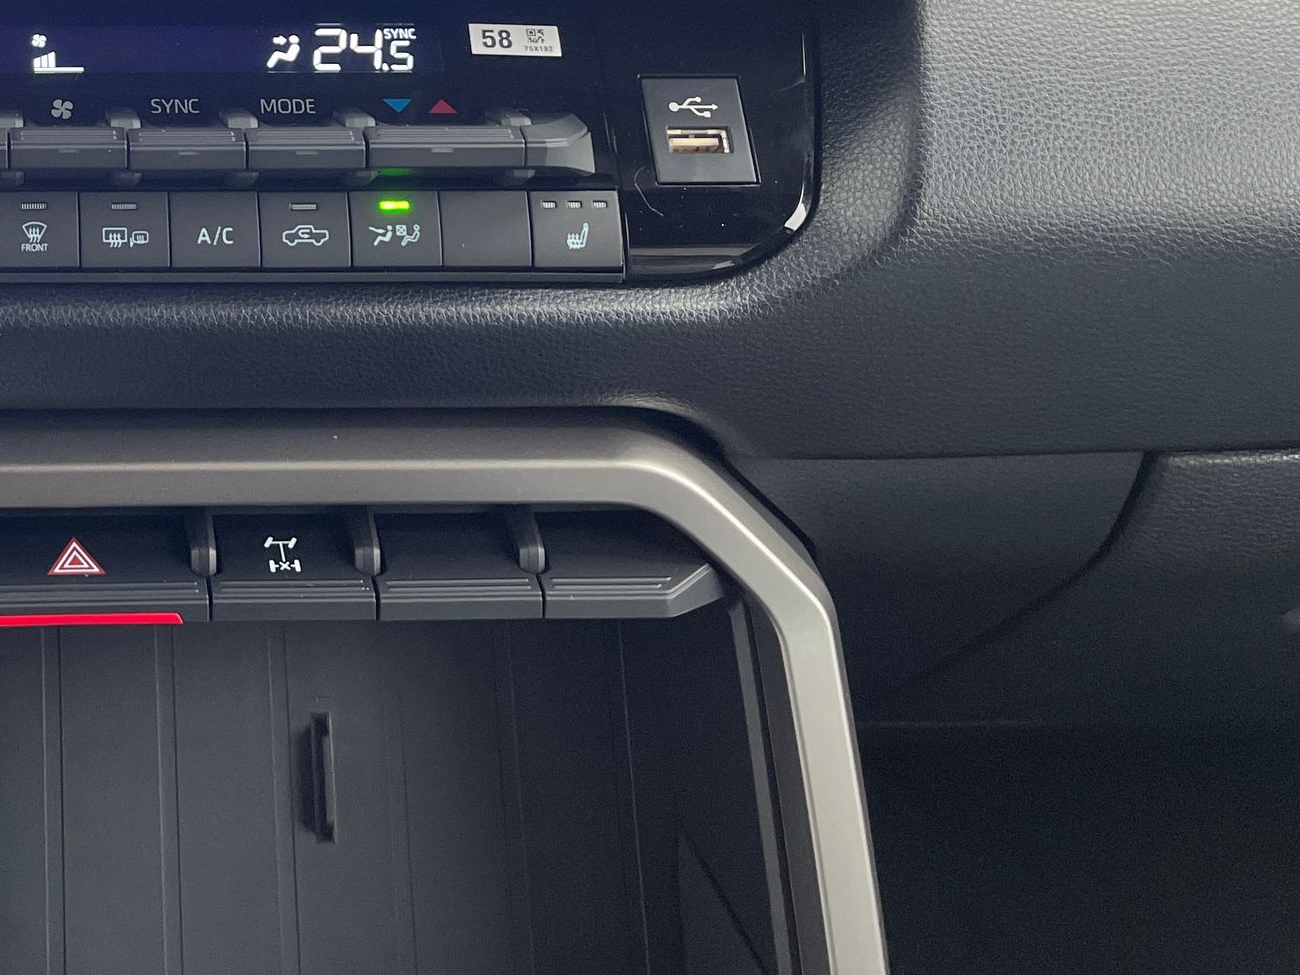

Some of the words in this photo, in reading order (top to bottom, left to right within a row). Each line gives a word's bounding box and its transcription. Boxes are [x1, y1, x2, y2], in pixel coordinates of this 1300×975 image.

[383, 27, 416, 39] SYNC
[482, 29, 512, 48] 58
[313, 29, 414, 71] 24.5
[150, 98, 200, 114] SYNC
[260, 98, 316, 115] MODE
[198, 226, 234, 245] A/C
[21, 243, 48, 251] FRONT
